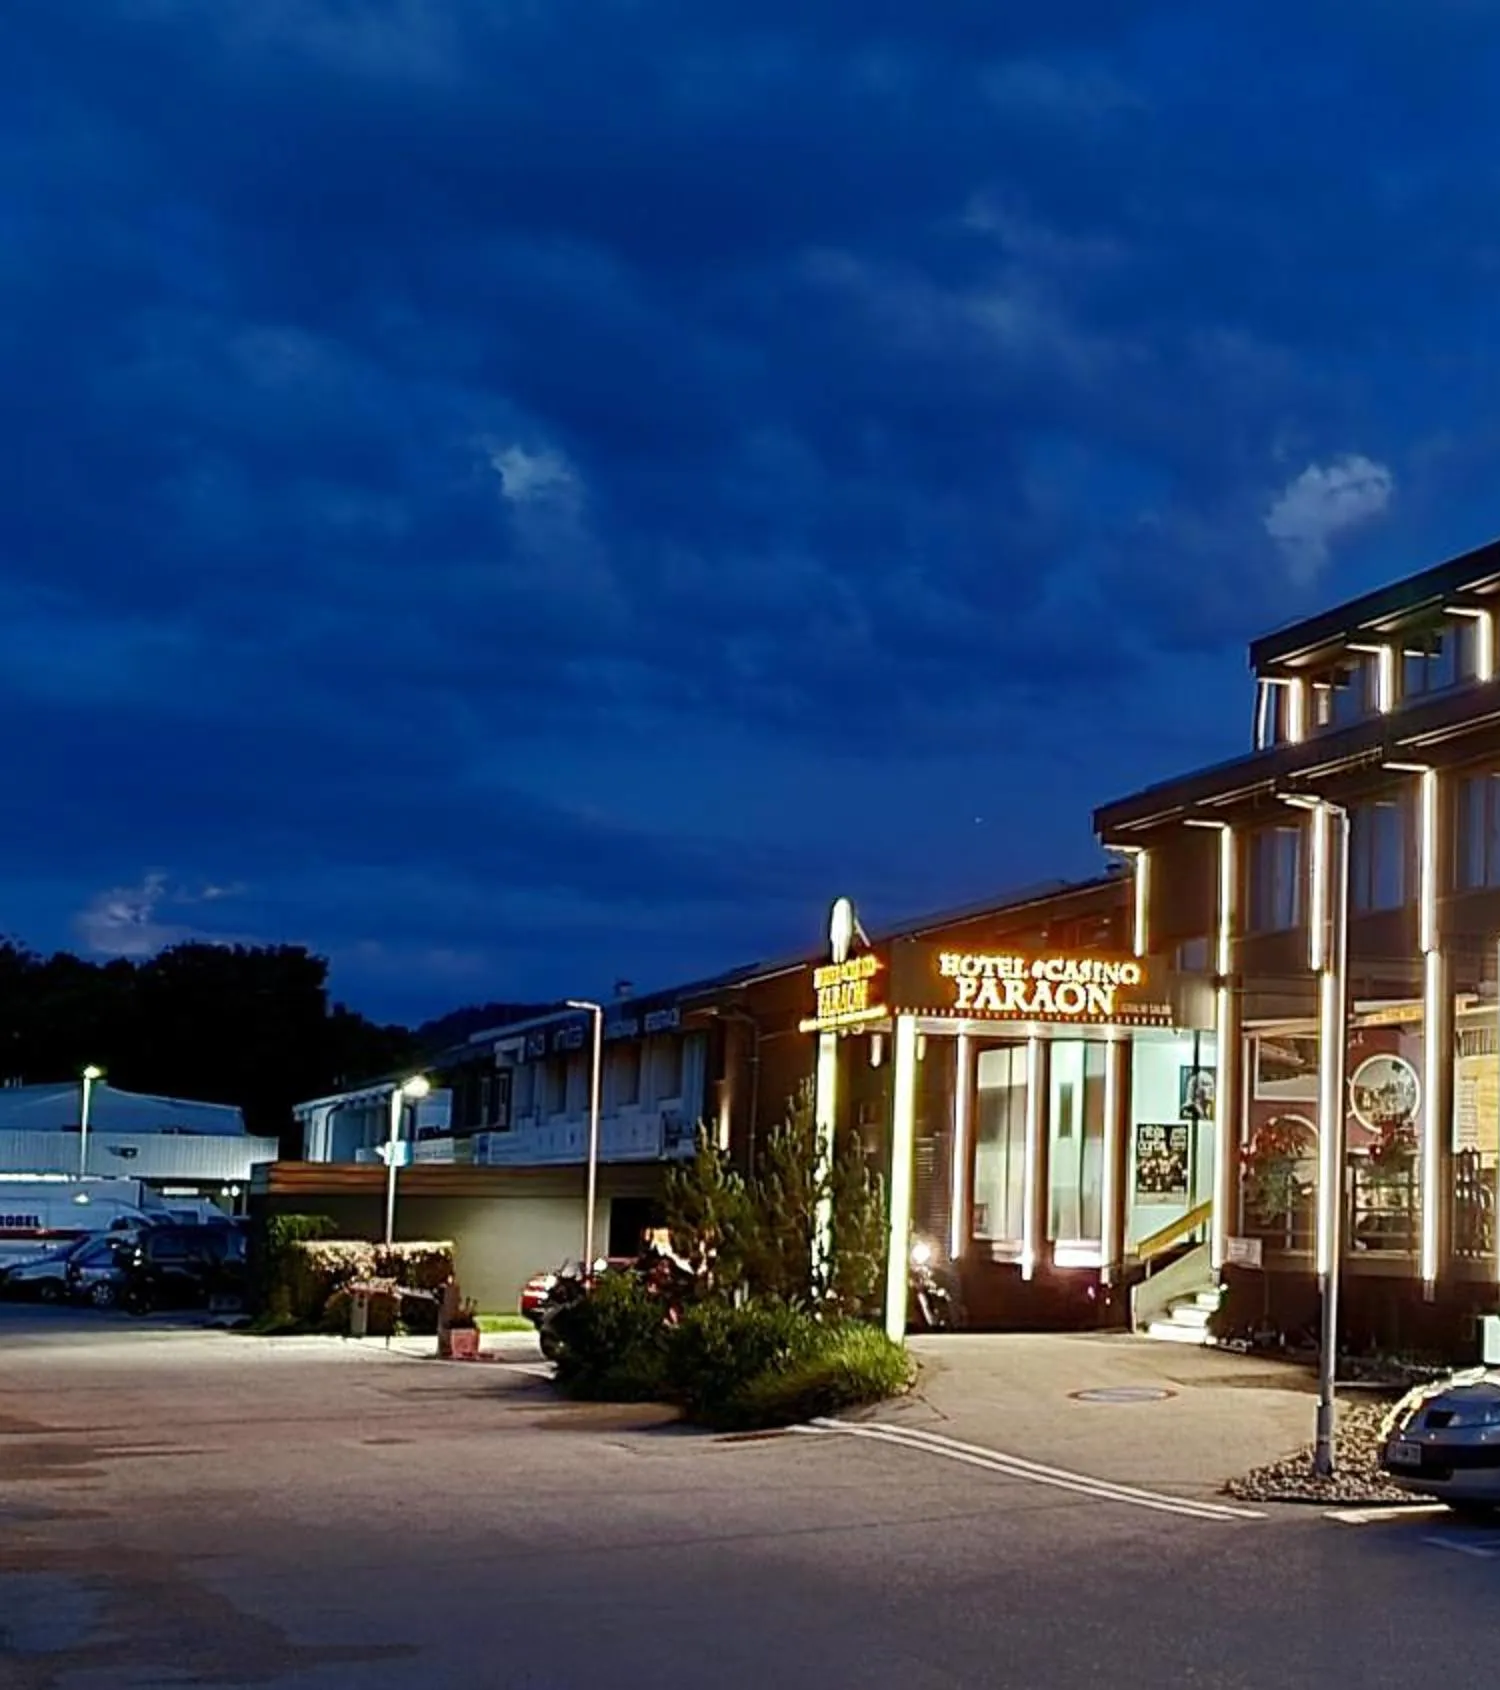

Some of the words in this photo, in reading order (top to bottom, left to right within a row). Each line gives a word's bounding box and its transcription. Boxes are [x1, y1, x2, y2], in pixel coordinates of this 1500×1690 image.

[939, 952, 1029, 979] HOTEL
[1045, 957, 1141, 985] CASINO
[954, 976, 1118, 1016] PARAON
